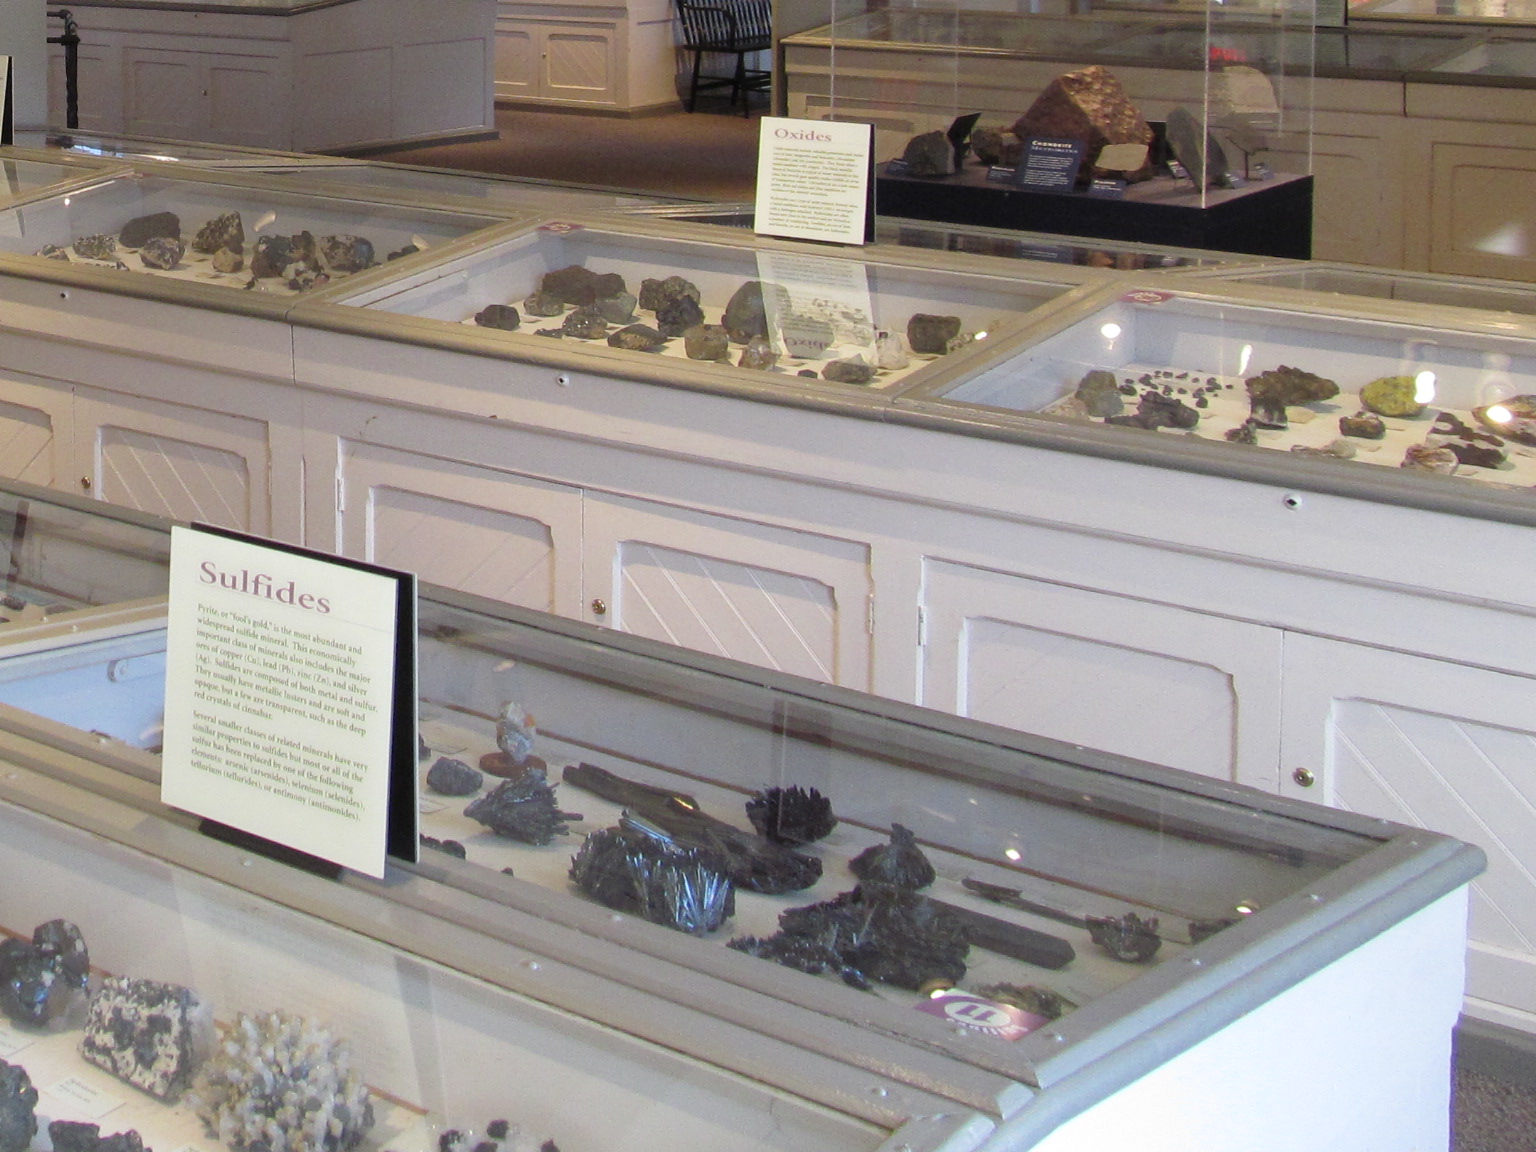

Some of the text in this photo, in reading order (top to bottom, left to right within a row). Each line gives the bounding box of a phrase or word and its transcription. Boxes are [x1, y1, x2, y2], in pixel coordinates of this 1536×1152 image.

[774, 128, 833, 142] Oxides
[199, 560, 331, 614] Sulfides
[197, 603, 219, 617] Pyrite,
[220, 611, 228, 619] or
[273, 624, 279, 632] is
[280, 626, 292, 636] the
[293, 631, 311, 641] most
[312, 634, 346, 650] abundant
[348, 645, 362, 654] and
[197, 617, 356, 667] widespread sulfide mineral. This economically
[195, 642, 210, 651] ores
[211, 645, 218, 653] of
[219, 648, 242, 660] copper
[262, 658, 277, 670] lead
[278, 662, 295, 676] (Pb),
[297, 670, 312, 679] zinc
[313, 672, 331, 686] (Zn),
[332, 680, 347, 689] and
[347, 683, 367, 695] silver
[195, 653, 377, 712] (Ag). Sulfides are composed of both metal and sulfur.
[196, 629, 370, 683] important class of minerals also includes the major
[193, 691, 272, 720] red crystals of cinnabar.
[194, 664, 365, 721] They usually have metallic lusters and are soft and
[221, 684, 233, 696] but
[239, 690, 251, 701] few
[252, 696, 263, 705] are
[264, 698, 307, 719] transparent,
[308, 713, 325, 723] such
[335, 718, 348, 729] the
[349, 721, 366, 736] deep
[192, 724, 362, 782] similar properties to sulfides but most or all of the
[192, 736, 353, 794] sulfur has been replaced by one of the following
[193, 709, 368, 772] Several smaller classes of related minerals have very
[190, 759, 221, 775] tellurium
[222, 769, 262, 790] (tellurides),
[272, 787, 306, 805] antimony
[307, 796, 360, 822] (antimonides).
[224, 759, 248, 772] arsenic
[250, 765, 290, 786] (arsenides),
[291, 780, 322, 795] selenium
[324, 788, 365, 810] (selenides),
[954, 1004, 997, 1023] 11
